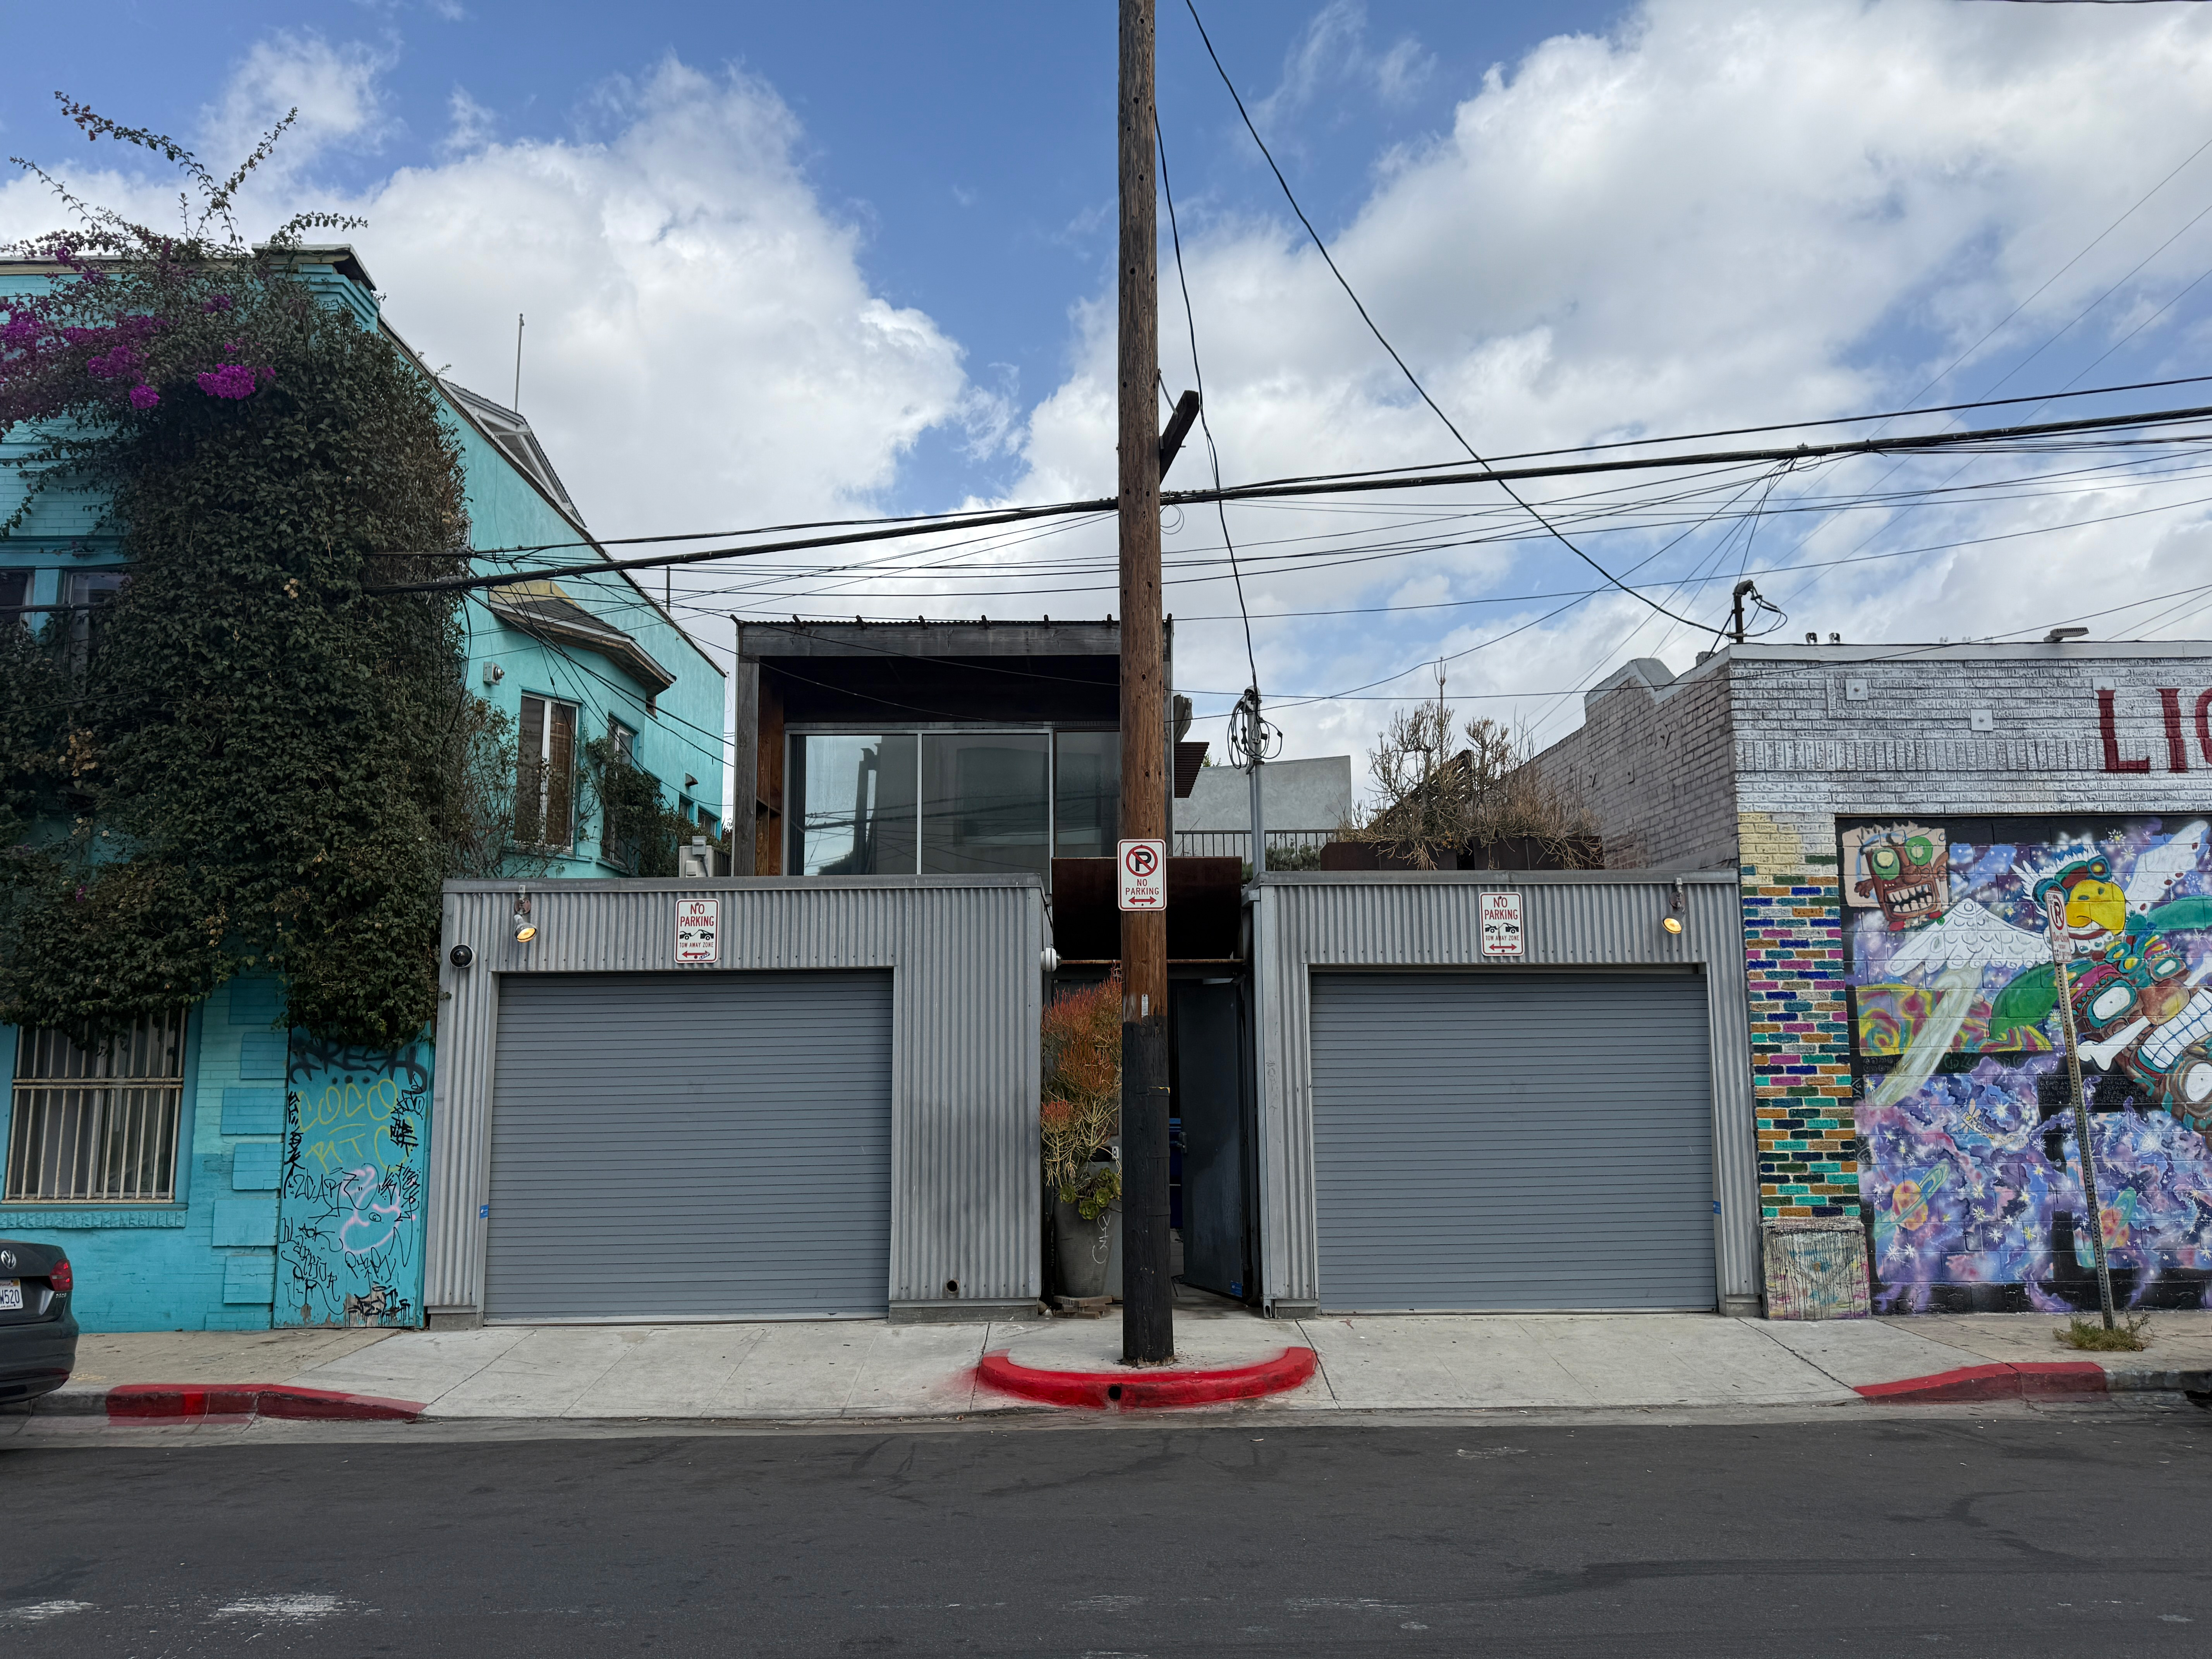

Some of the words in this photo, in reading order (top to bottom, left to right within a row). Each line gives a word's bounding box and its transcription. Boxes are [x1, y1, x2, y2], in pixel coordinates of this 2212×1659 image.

[1493, 897, 1508, 908] NO
[690, 904, 705, 914] NO
[1484, 909, 1518, 920] PARKING
[680, 916, 714, 927] PARKING
